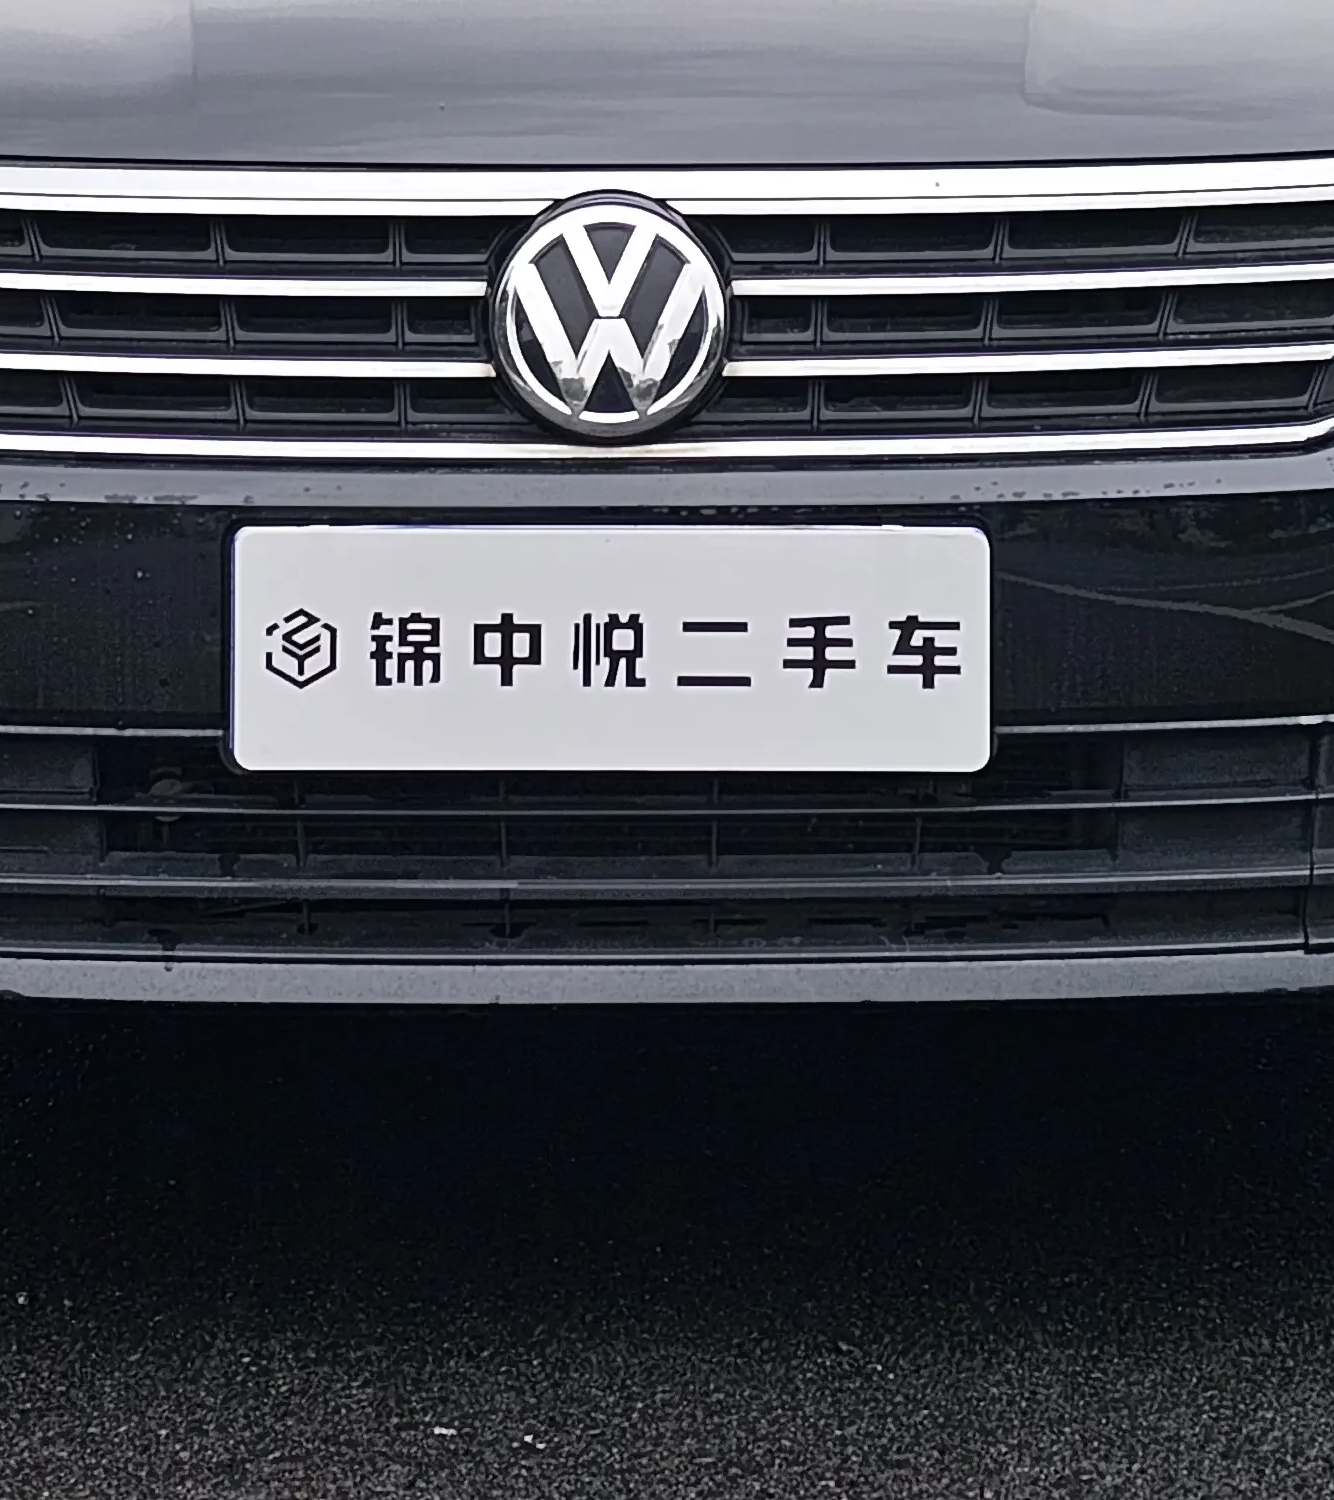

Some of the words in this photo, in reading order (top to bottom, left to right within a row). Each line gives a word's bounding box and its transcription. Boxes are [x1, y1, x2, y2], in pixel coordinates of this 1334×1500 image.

[503, 206, 715, 420] VW
[369, 611, 962, 690] 锦中悦二手车
